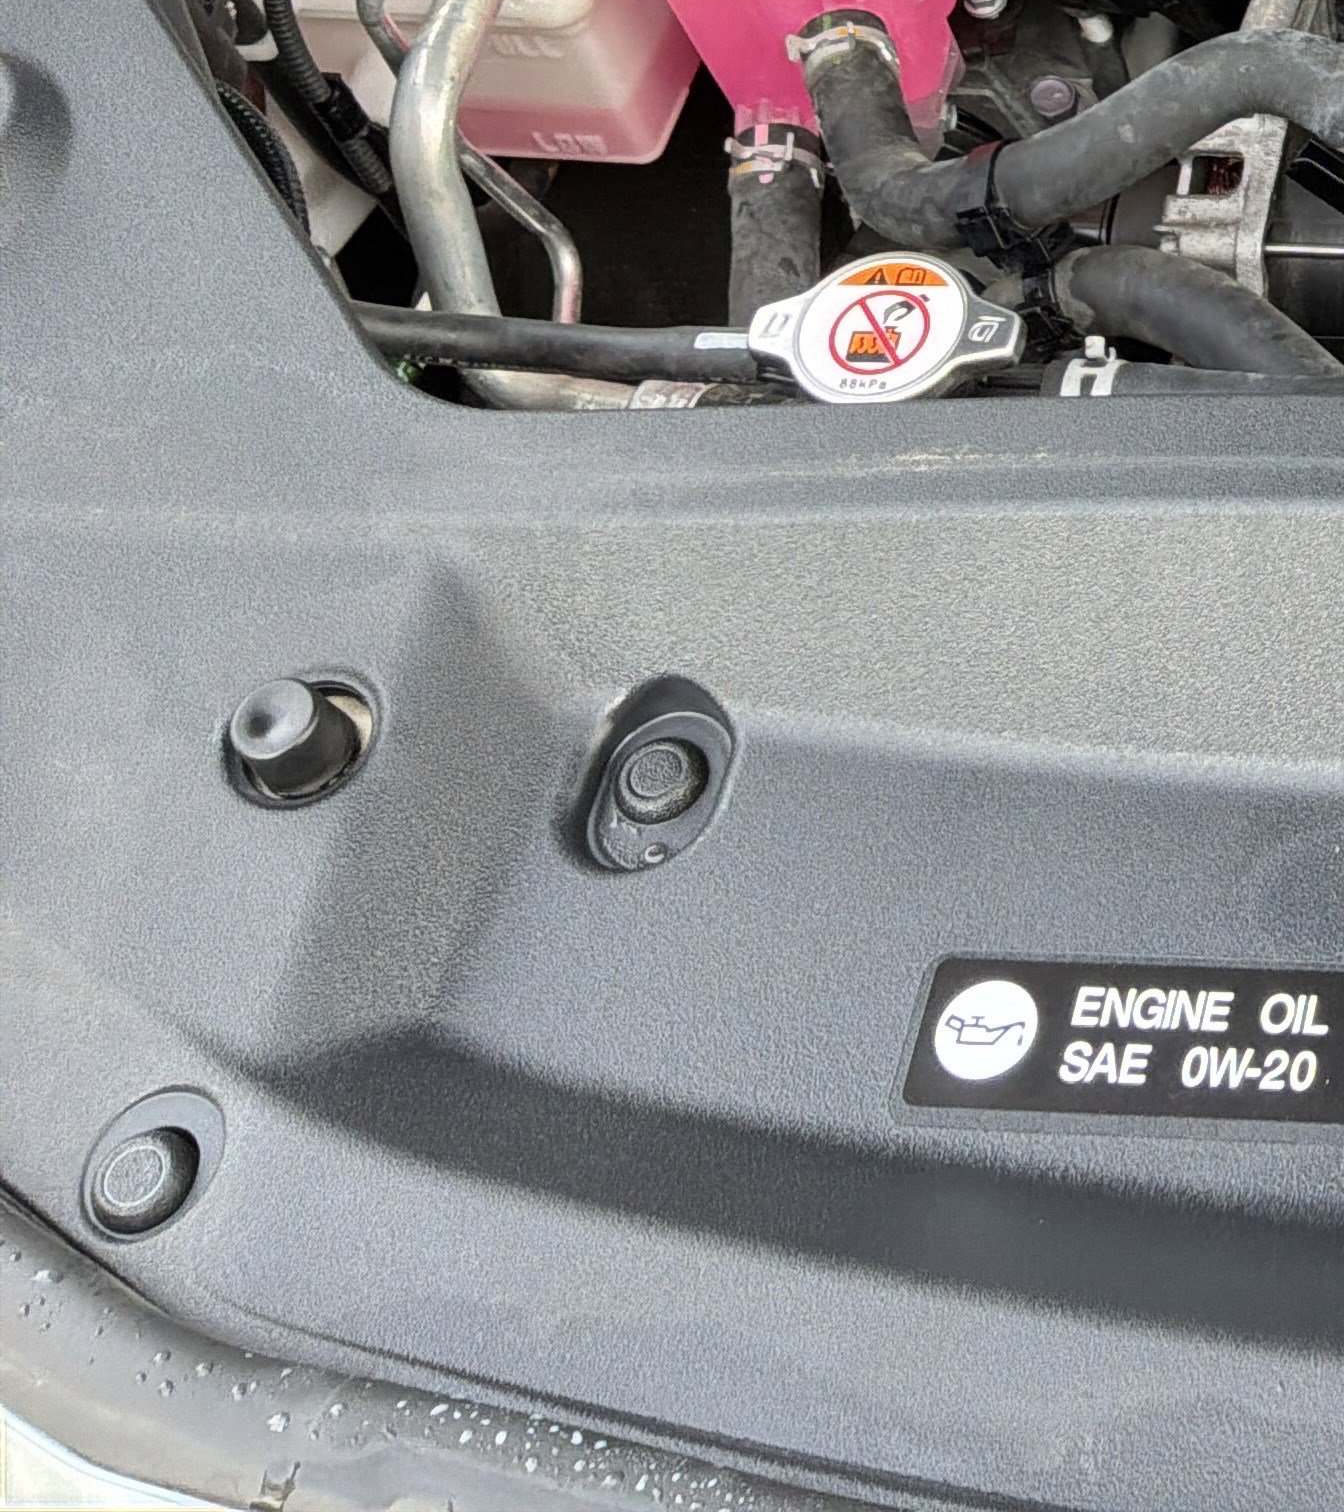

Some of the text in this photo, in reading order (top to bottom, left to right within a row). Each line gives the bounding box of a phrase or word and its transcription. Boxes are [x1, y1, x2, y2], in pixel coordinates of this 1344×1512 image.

[1071, 986, 1329, 1036] ENGINE OIL
[1059, 1040, 1317, 1092] SAE 0W-20
